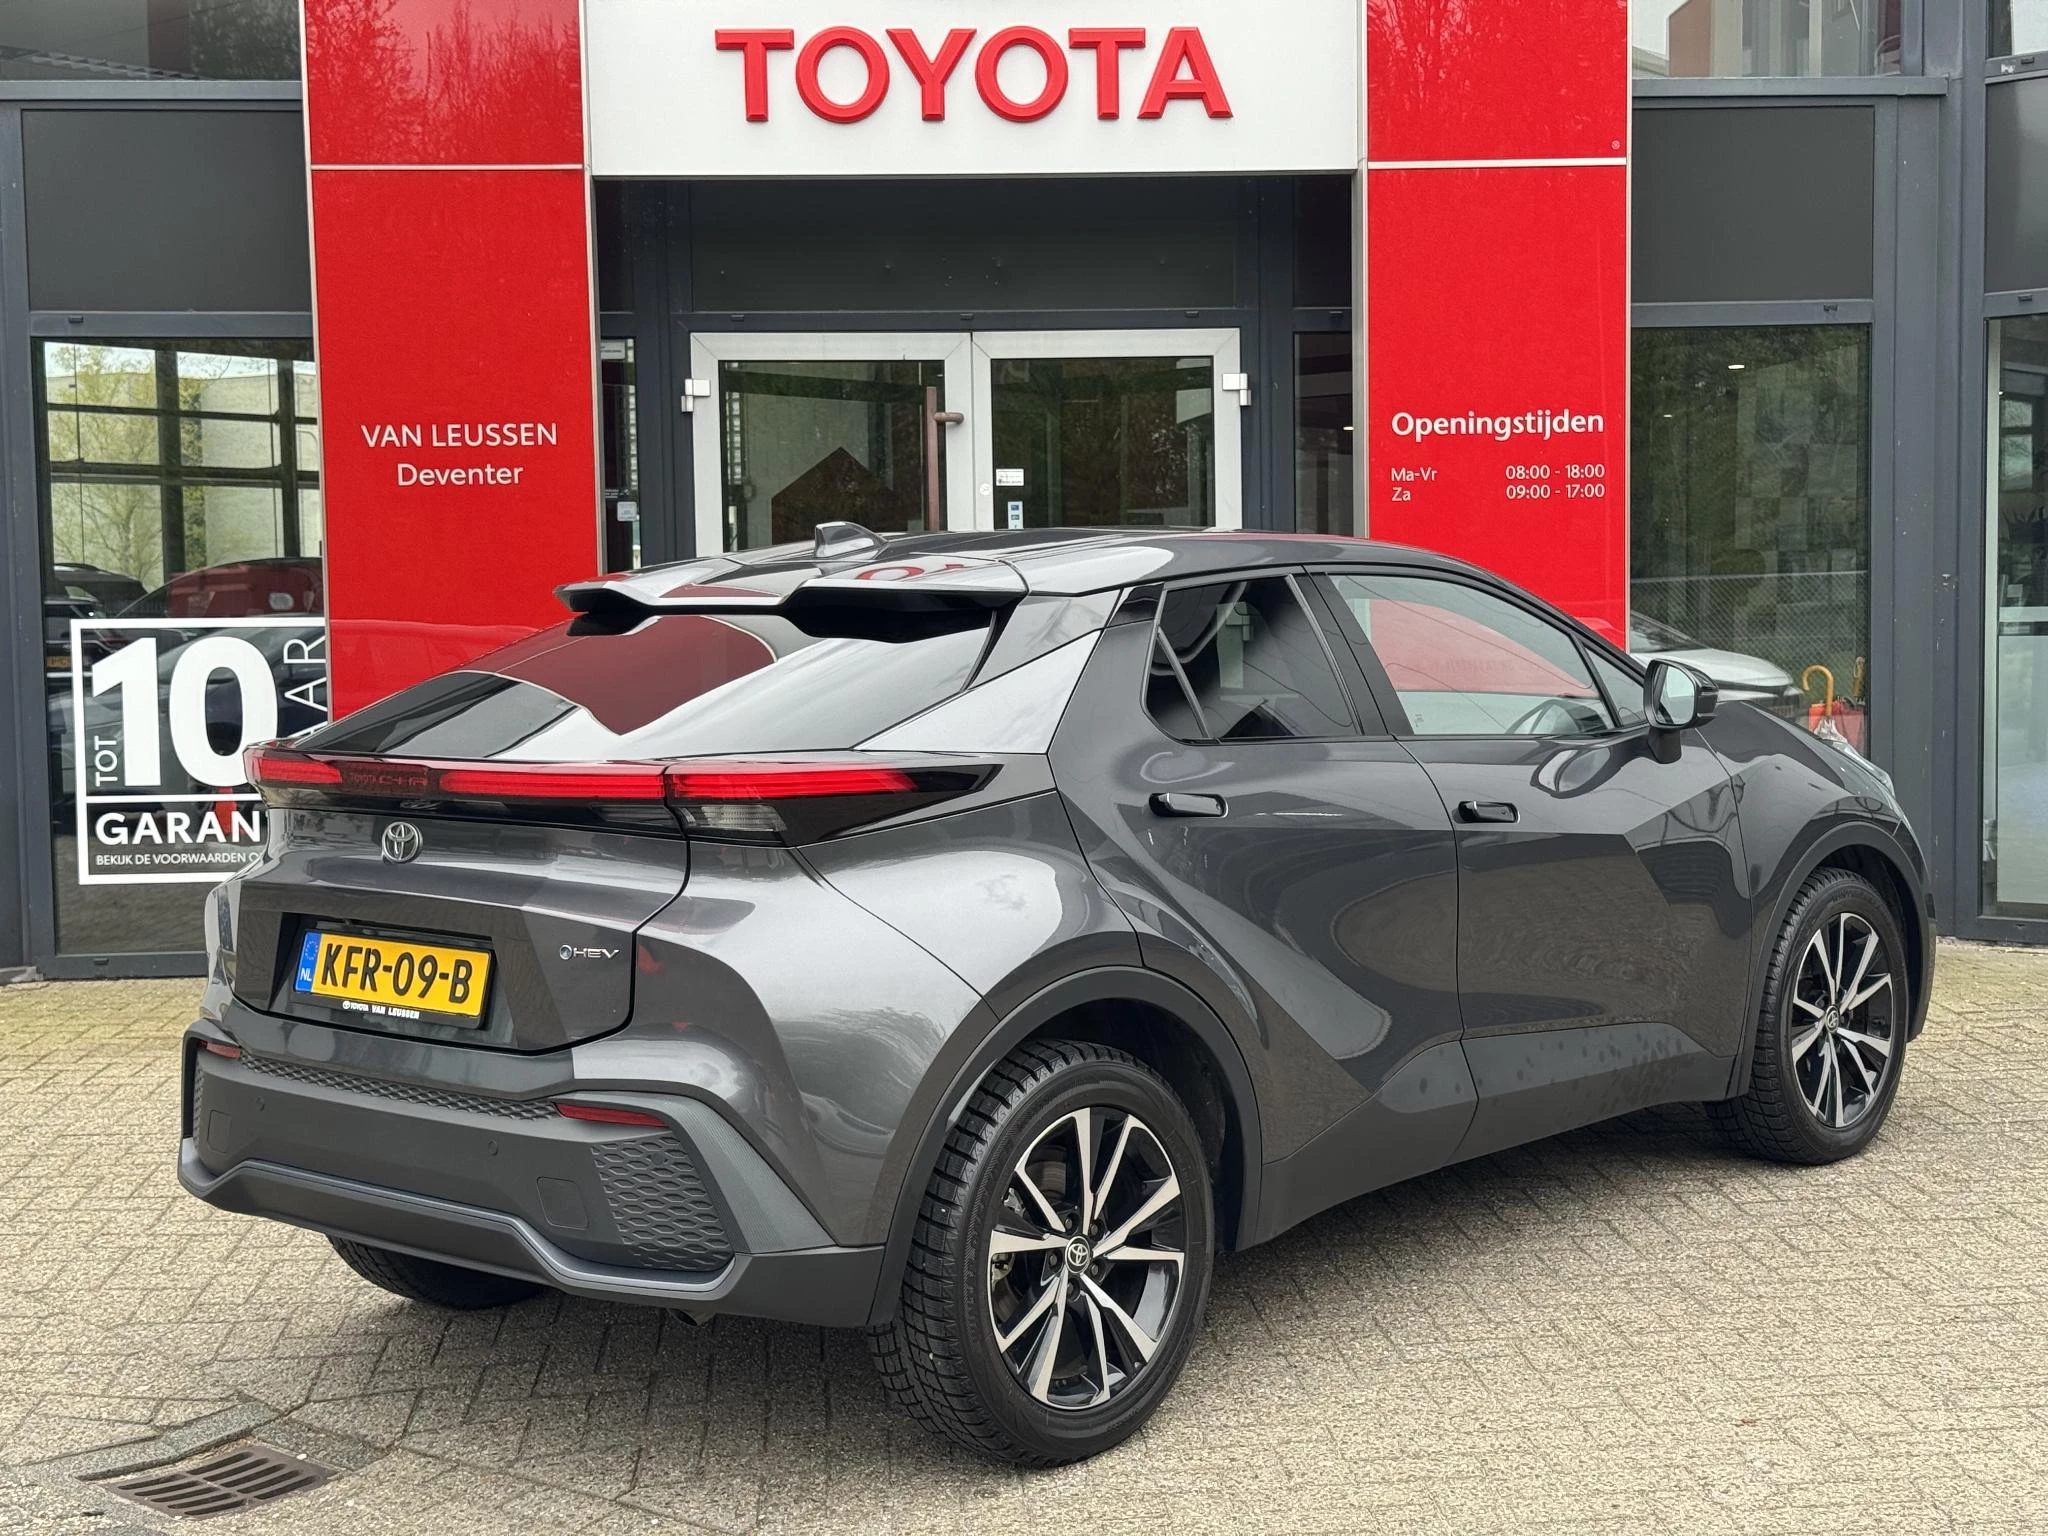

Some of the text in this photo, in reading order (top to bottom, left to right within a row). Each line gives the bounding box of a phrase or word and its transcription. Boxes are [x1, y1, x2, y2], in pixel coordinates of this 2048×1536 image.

[715, 26, 1234, 124] TOYOTA
[361, 423, 558, 448] VAN LEUSSEN
[1391, 409, 1604, 442] Openingstijden
[397, 463, 524, 487] Deventer
[1391, 467, 1437, 482] Ma-Vr
[1505, 465, 1550, 480] 08:00
[1565, 464, 1605, 479] 18:00
[1391, 487, 1412, 502] Za
[1506, 484, 1550, 499] 09:00
[1565, 483, 1605, 498] 17:00
[92, 636, 279, 788] 10
[95, 735, 118, 787] TOT
[95, 810, 262, 846] GARAN
[96, 854, 134, 866] BEKIJK
[135, 854, 151, 865] DE
[152, 852, 247, 865] VOORWAARDEN
[573, 947, 620, 958] HEV
[300, 943, 472, 1004] NL KFR-09-B
[371, 1004, 386, 1015] VAN
[388, 1007, 420, 1020] LEUSSEN
